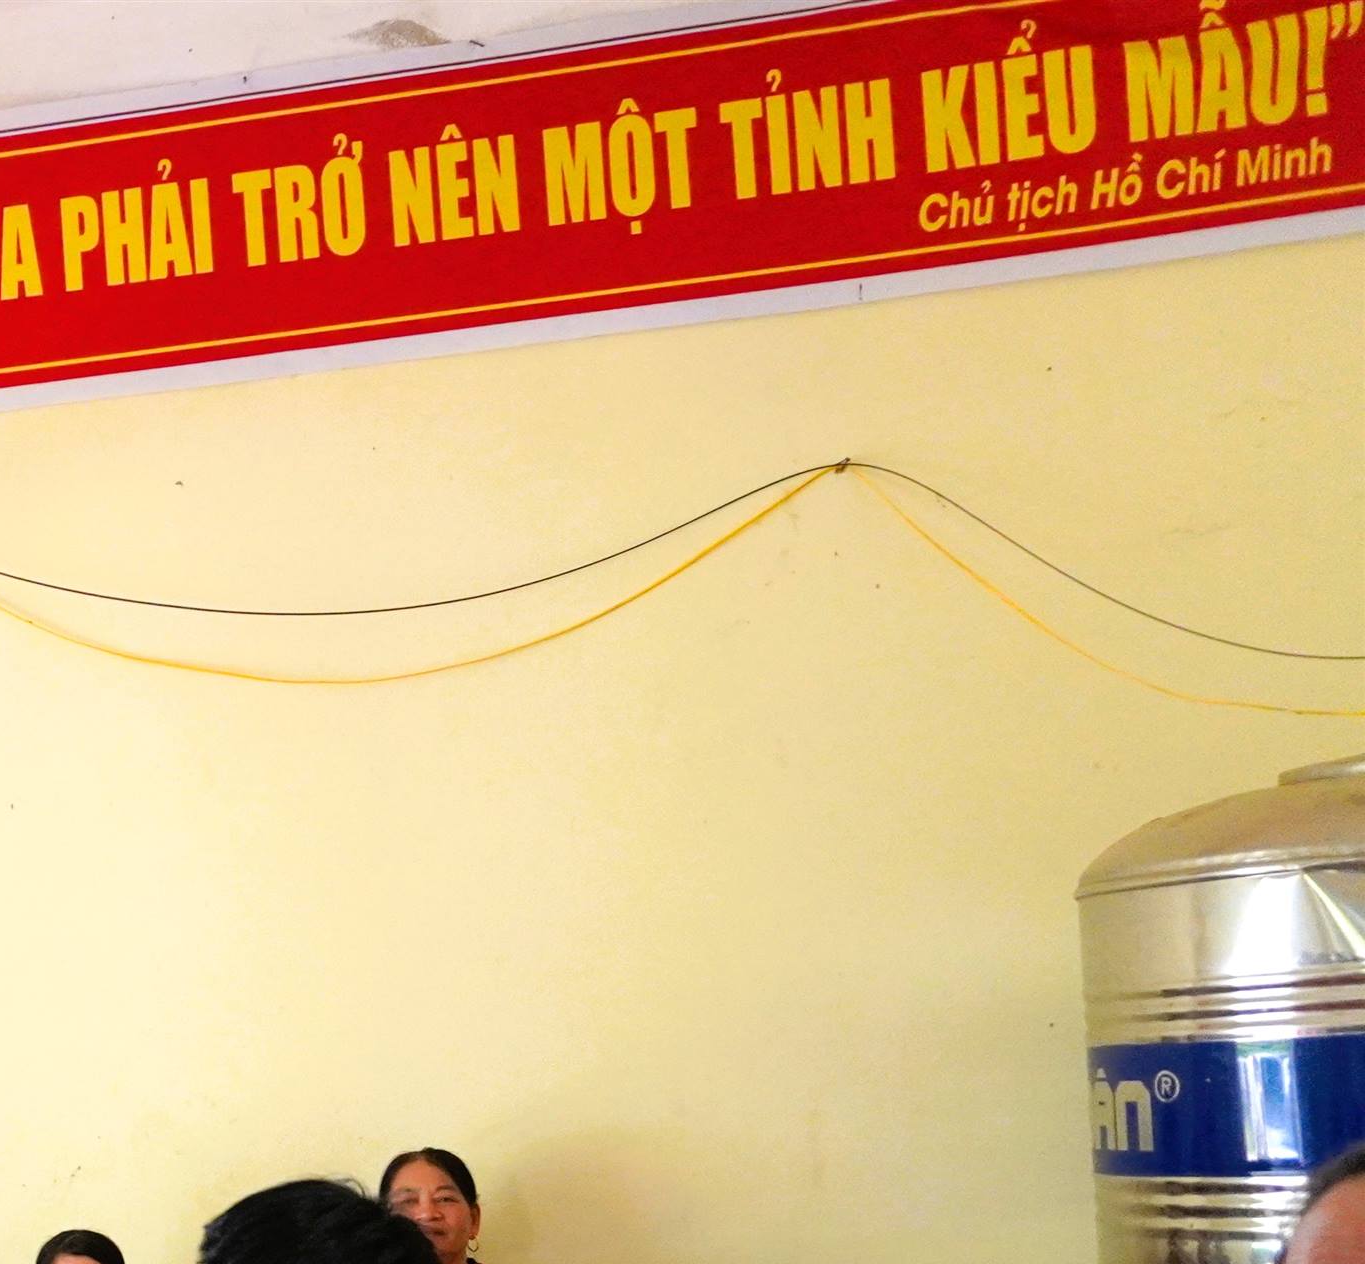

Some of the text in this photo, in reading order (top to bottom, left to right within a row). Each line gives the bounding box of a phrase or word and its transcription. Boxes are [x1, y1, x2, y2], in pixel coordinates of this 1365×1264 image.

[60, 158, 214, 292] PHẢI
[231, 133, 366, 267] TRỞ
[388, 123, 521, 247] NÊN
[542, 98, 697, 235] MỘT
[719, 69, 896, 200] TỈNH
[921, 20, 1097, 173] KIỂU
[919, 136, 1333, 232] Chủ tịch Hồ Chí Minh
